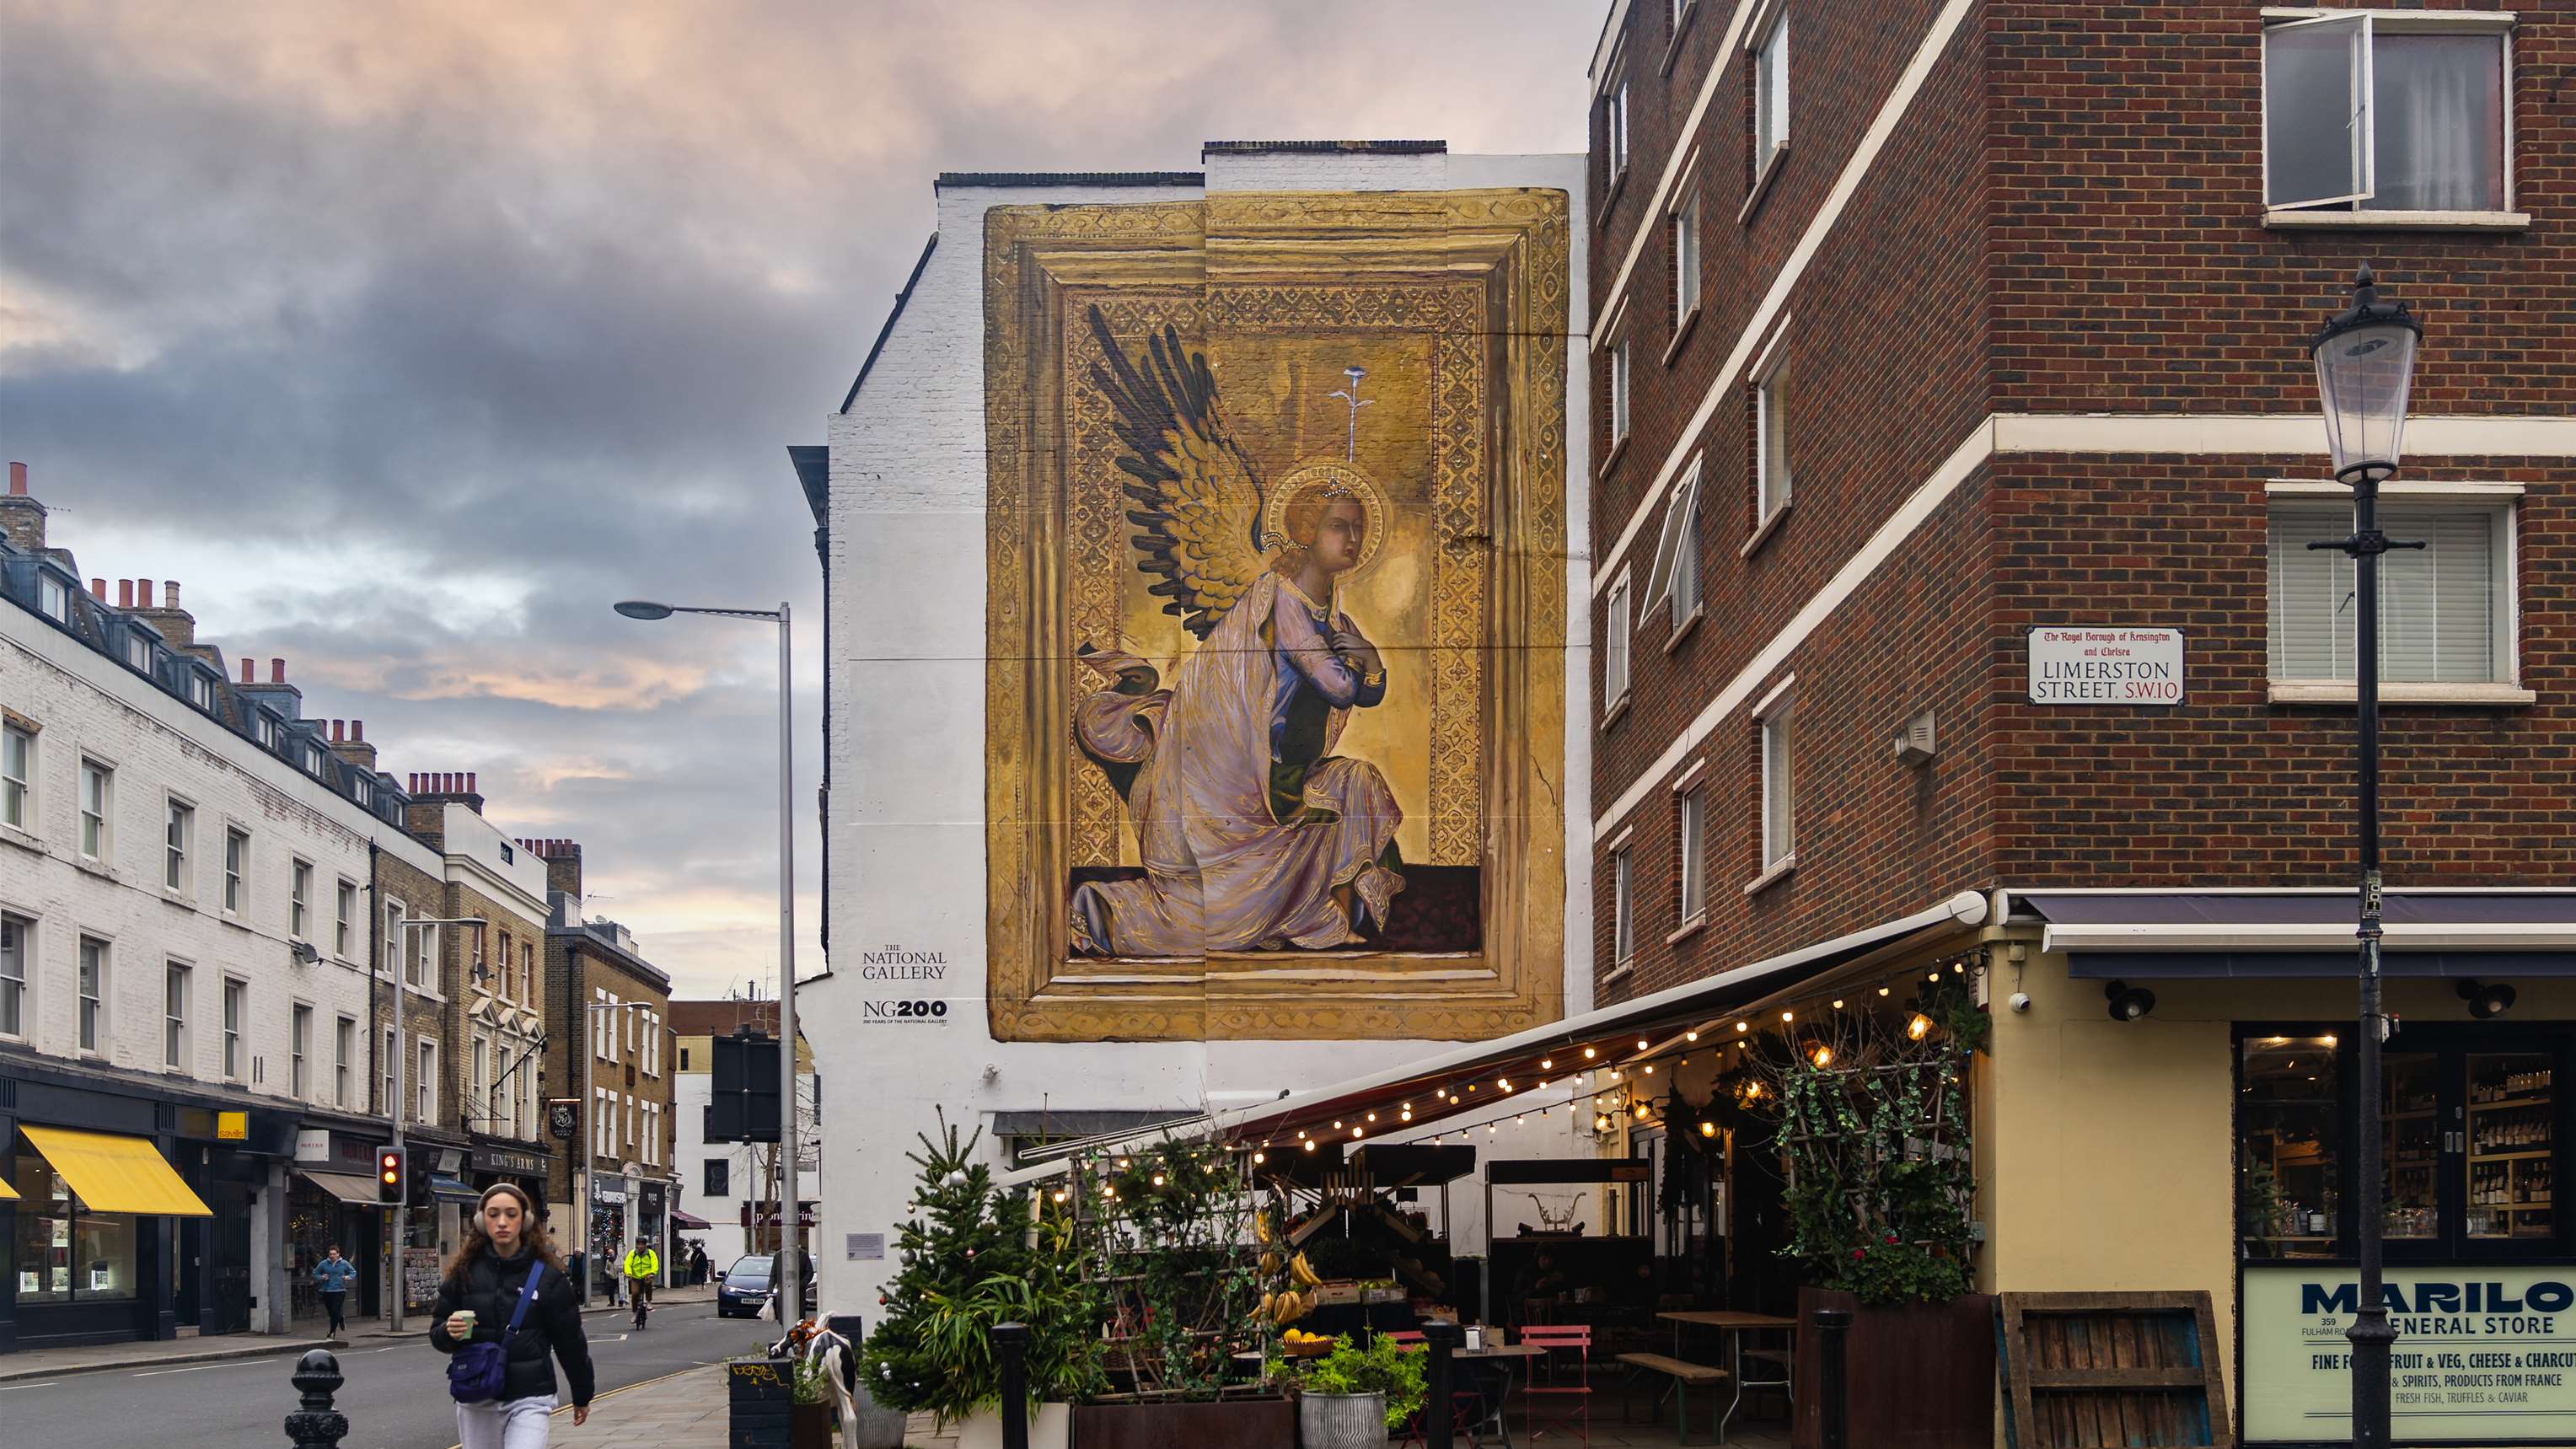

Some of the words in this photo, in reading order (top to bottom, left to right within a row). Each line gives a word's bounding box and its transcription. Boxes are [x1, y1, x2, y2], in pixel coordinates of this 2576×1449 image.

[2044, 632, 2058, 641] The
[2061, 632, 2082, 644] Royal
[2085, 632, 2116, 644] Borough
[2119, 632, 2127, 641] of
[2130, 632, 2170, 644] Kensington
[2084, 647, 2097, 657] and
[2101, 647, 2130, 657] Chelsea
[2043, 662, 2169, 679] LIMERSTON
[863, 952, 947, 964] NATIONAL
[862, 966, 946, 979] GALLERY
[863, 1000, 947, 1017] NG200
[491, 1152, 514, 1167] KING'S
[516, 1157, 534, 1171] ARMS
[2301, 1281, 2575, 1314] MARILO
[2321, 1318, 2337, 1326] 359
[2390, 1316, 2477, 1335] ENERAL
[2485, 1316, 2554, 1334] STORE
[2312, 1354, 2339, 1370] FINE
[2390, 1354, 2423, 1369] FRUIT
[2426, 1356, 2434, 1369] &
[2438, 1353, 2466, 1371] VEG,
[2469, 1353, 2512, 1369] CHEESE
[2514, 1355, 2523, 1368] &
[2391, 1377, 2399, 1388] &
[2402, 1374, 2442, 1389] SPIRITS,
[2445, 1374, 2493, 1387] PRODUCTS
[2496, 1374, 2522, 1387] FROM
[2525, 1373, 2563, 1387] FRANCE
[2396, 1393, 2421, 1403] FRESH
[2423, 1393, 2445, 1404] FISH,
[2447, 1392, 2485, 1403] TRUFFLES
[2487, 1393, 2496, 1403] &
[2498, 1392, 2528, 1403] CAVIAR
